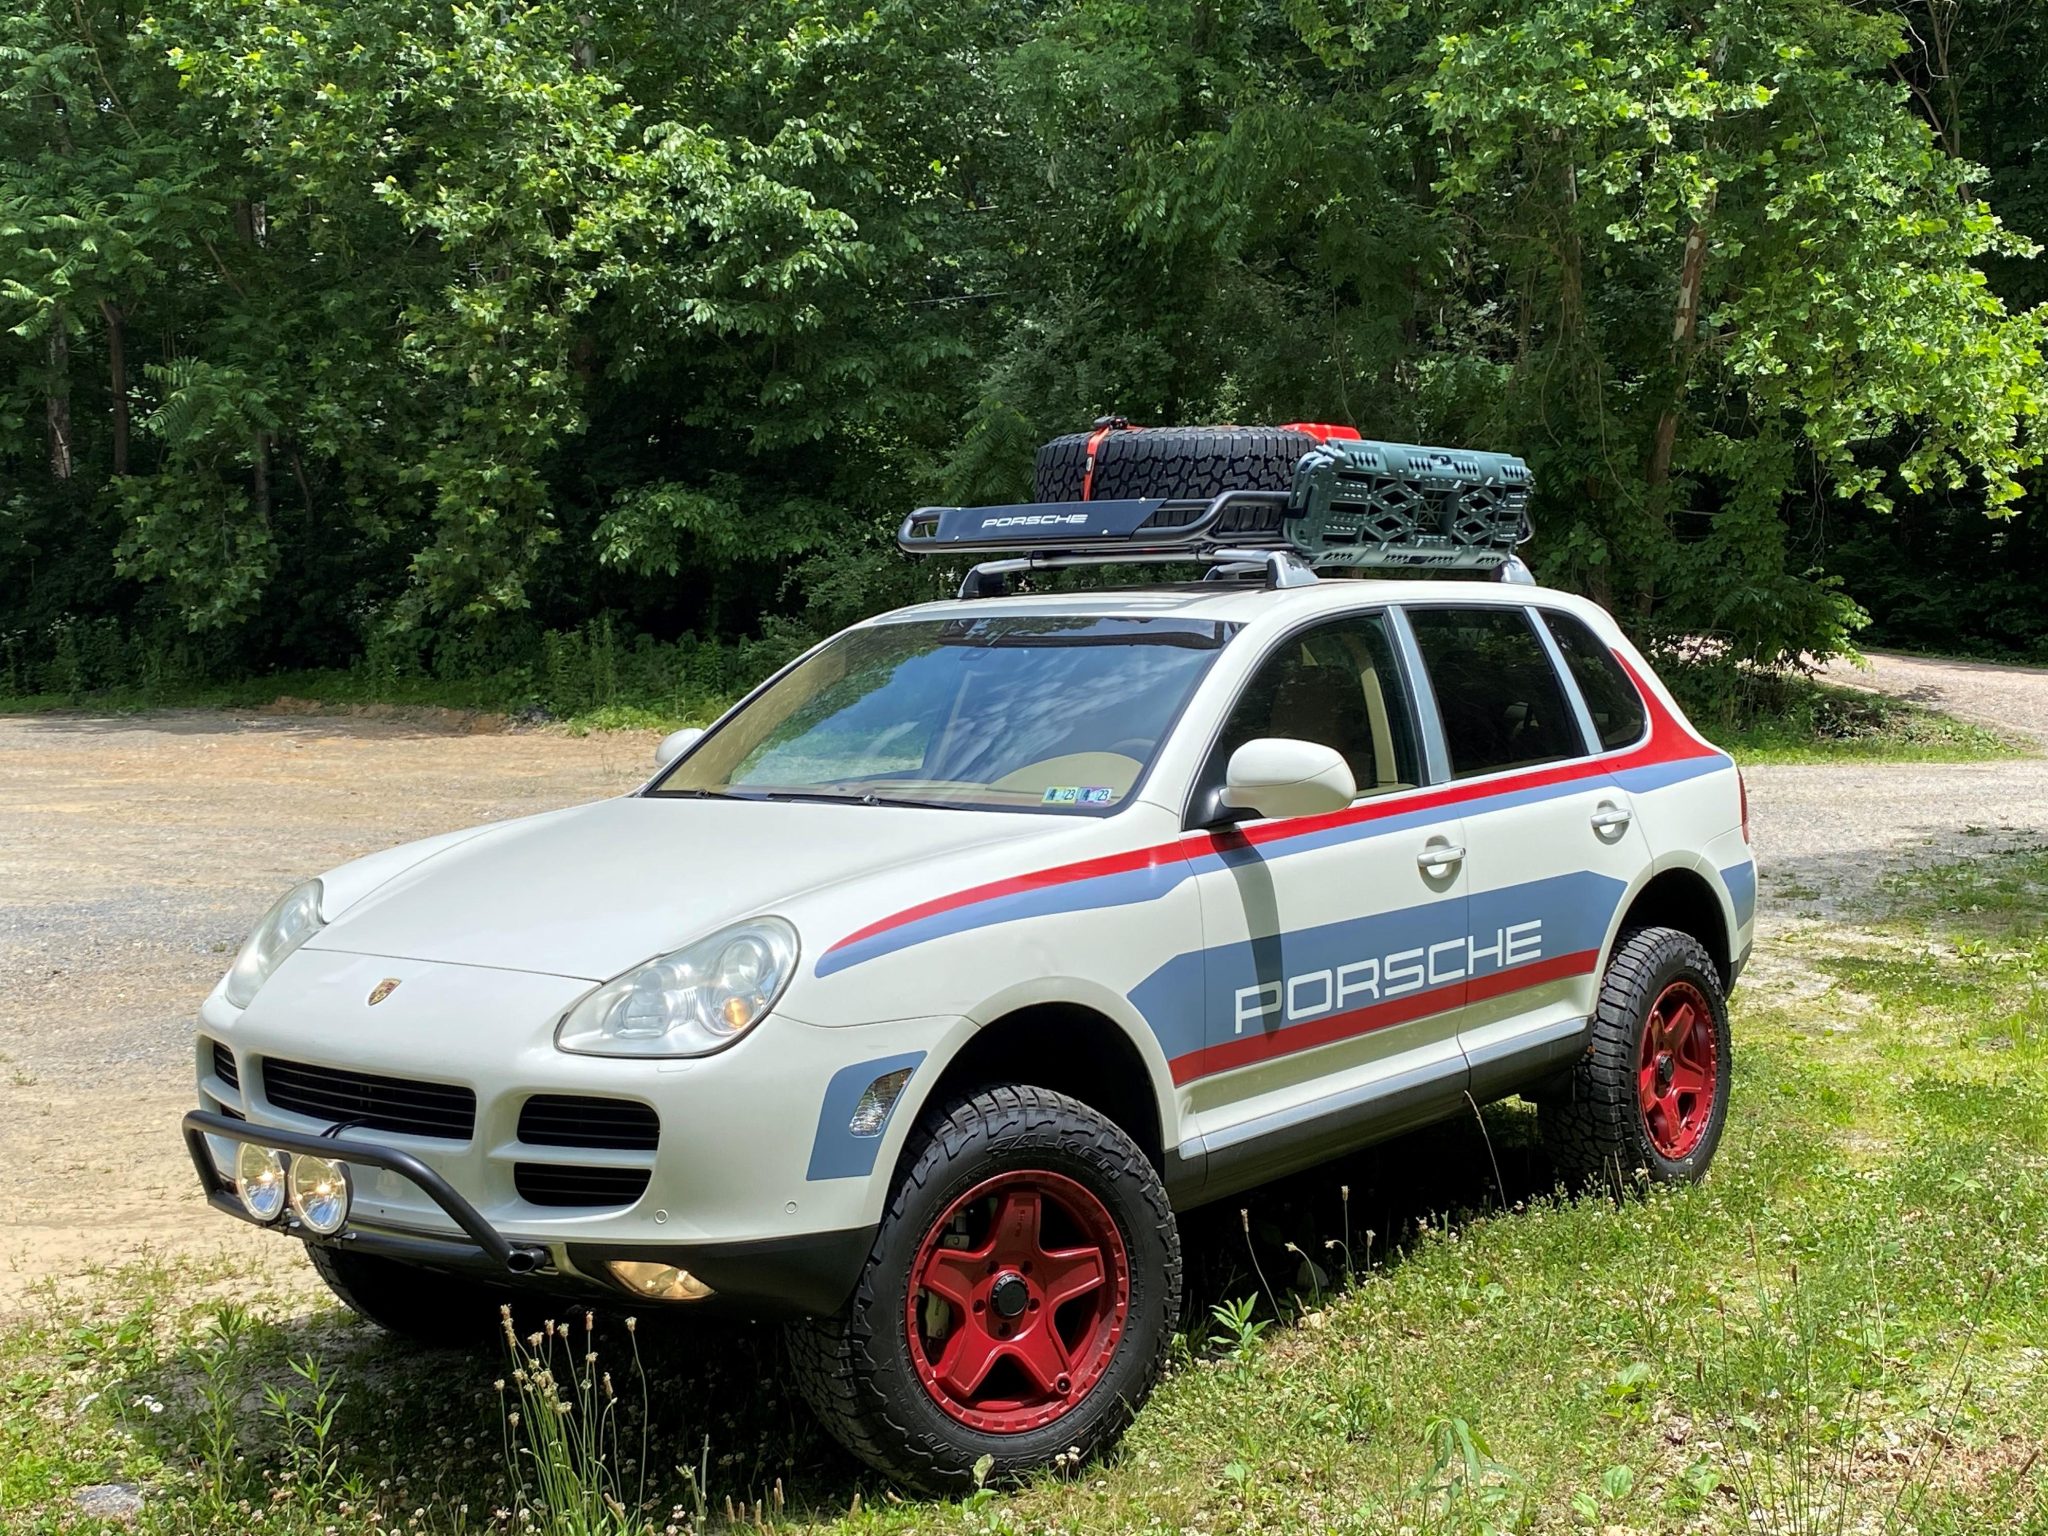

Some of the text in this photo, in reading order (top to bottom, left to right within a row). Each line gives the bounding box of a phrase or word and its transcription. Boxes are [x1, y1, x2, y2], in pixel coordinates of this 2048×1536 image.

[981, 513, 1089, 529] PORSCHE
[1064, 789, 1076, 801] 23
[1097, 789, 1110, 801] 23
[1235, 919, 1543, 1034] PORSCHE
